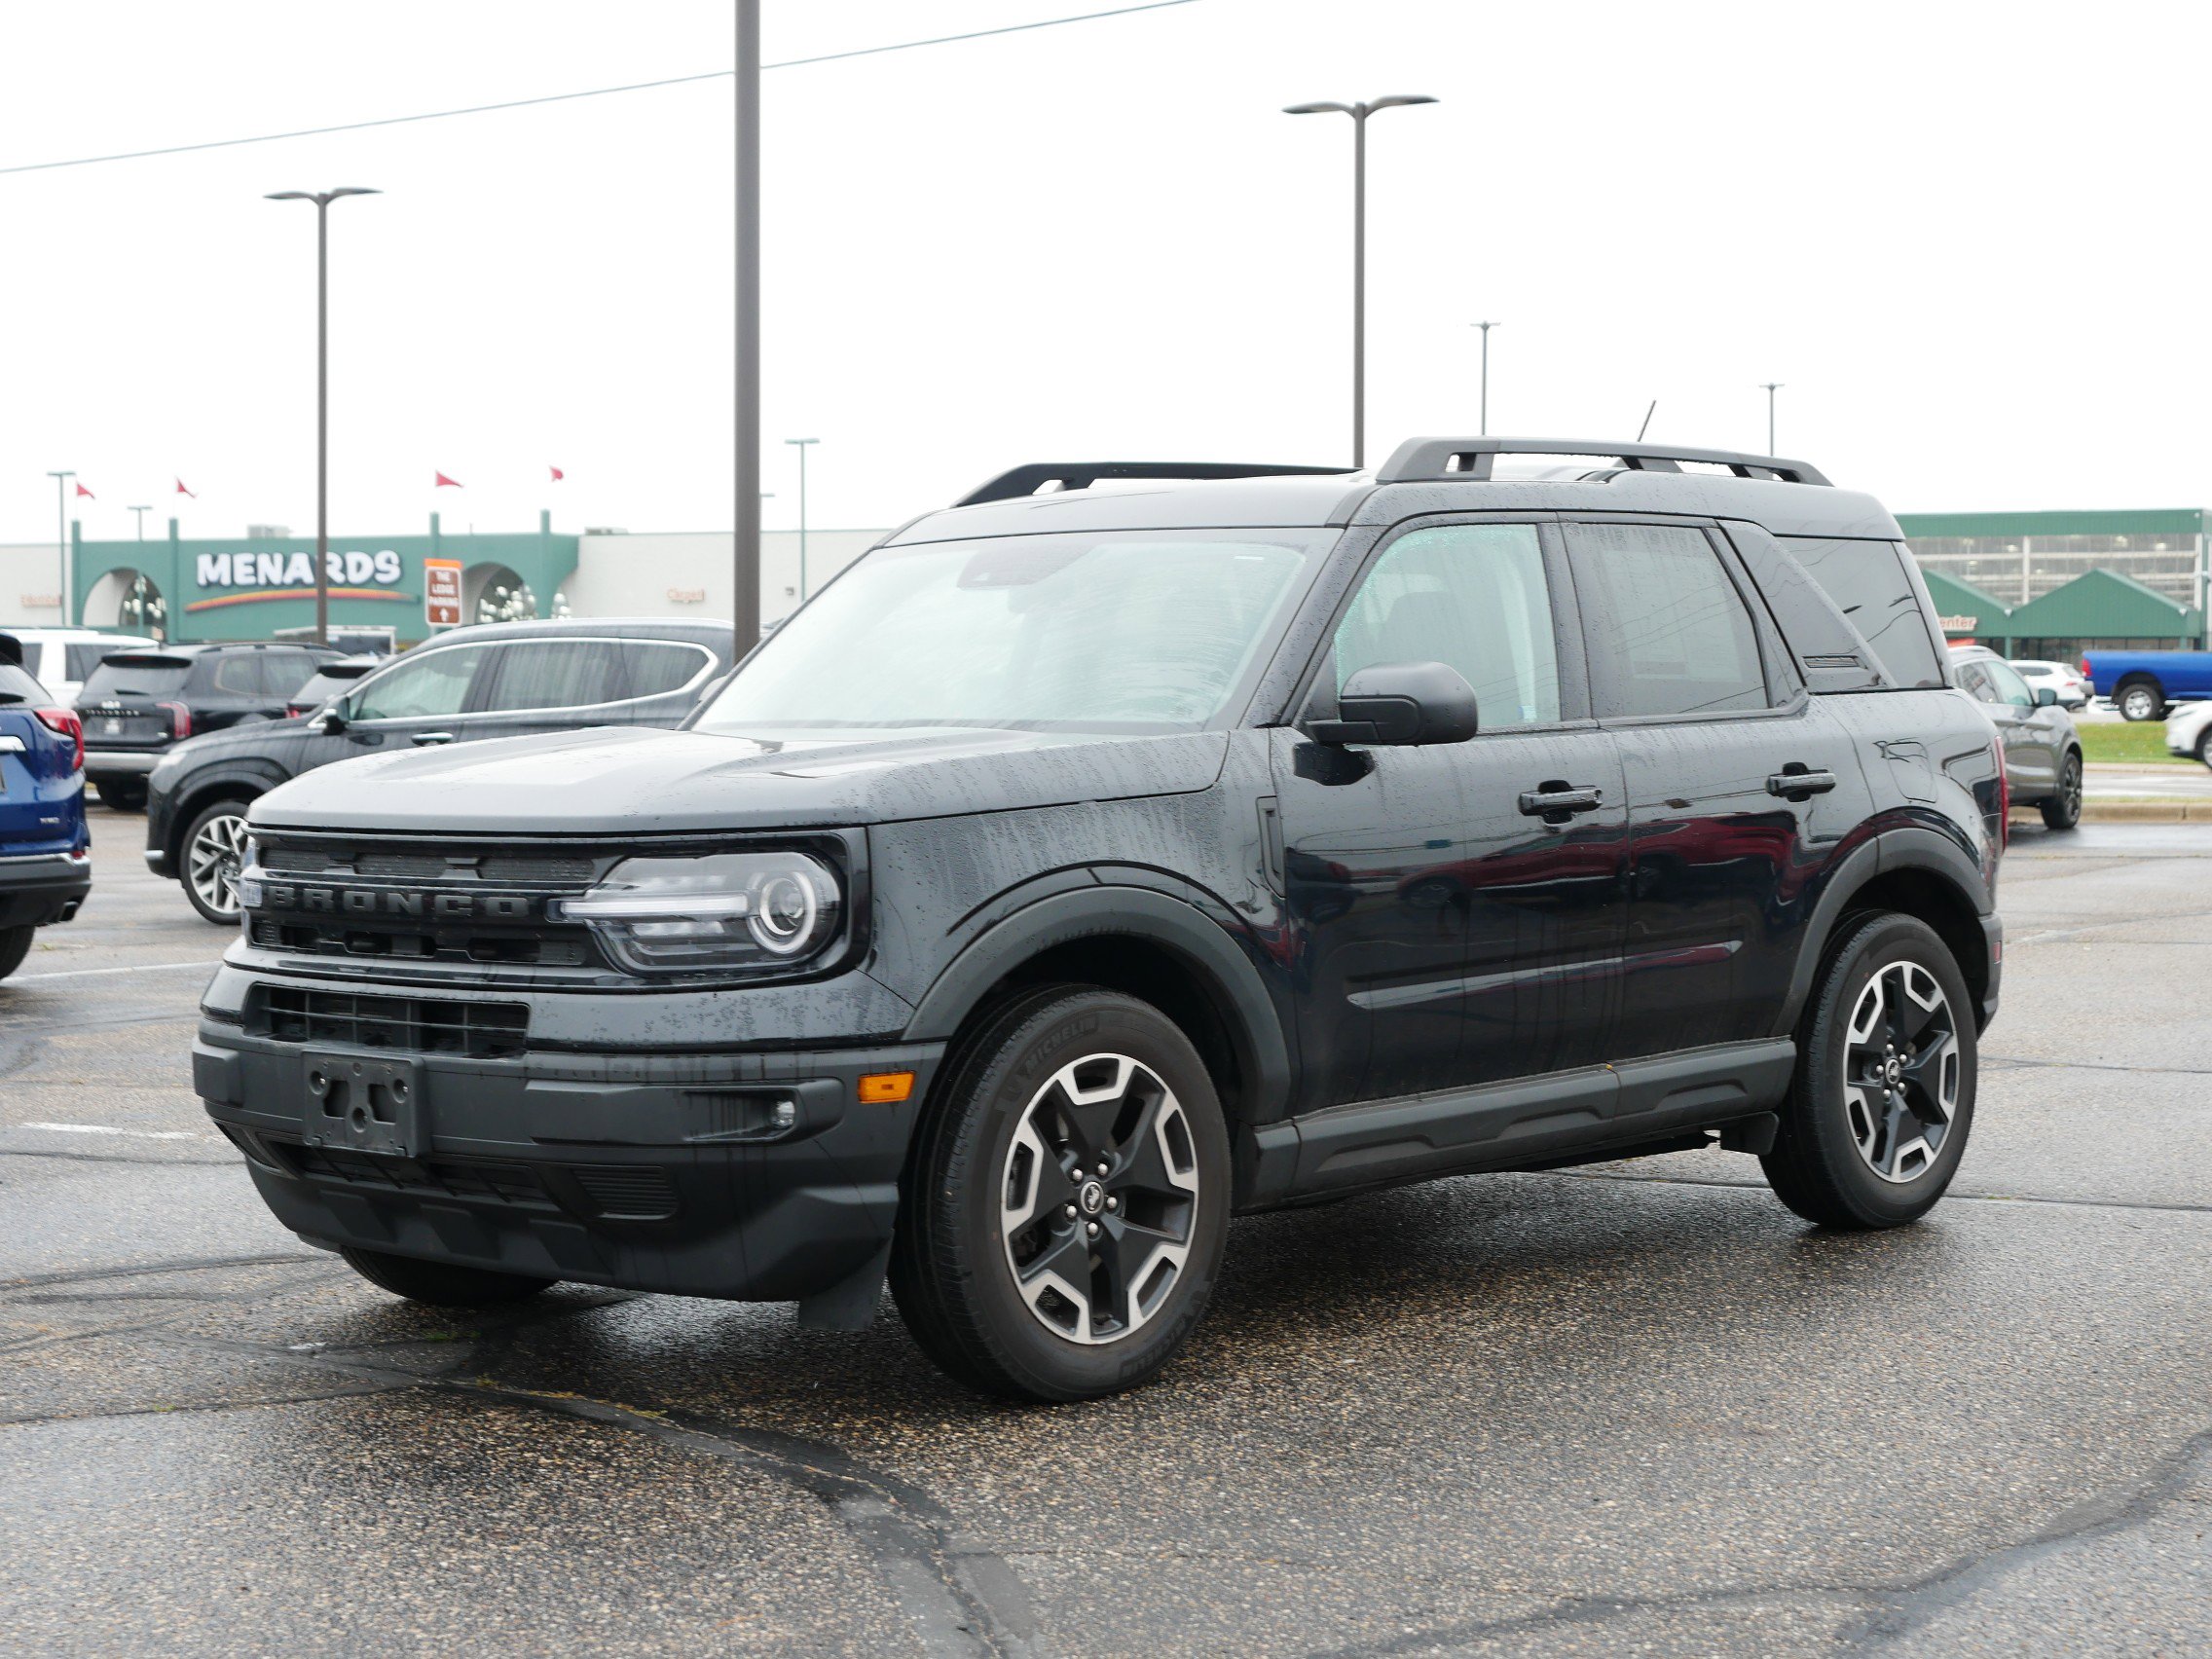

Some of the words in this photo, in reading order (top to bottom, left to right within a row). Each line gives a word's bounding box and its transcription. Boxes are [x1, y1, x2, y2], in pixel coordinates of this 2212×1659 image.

[198, 550, 401, 586] MENARDS
[1938, 614, 1977, 631] enter
[268, 886, 530, 918] BRONCO
